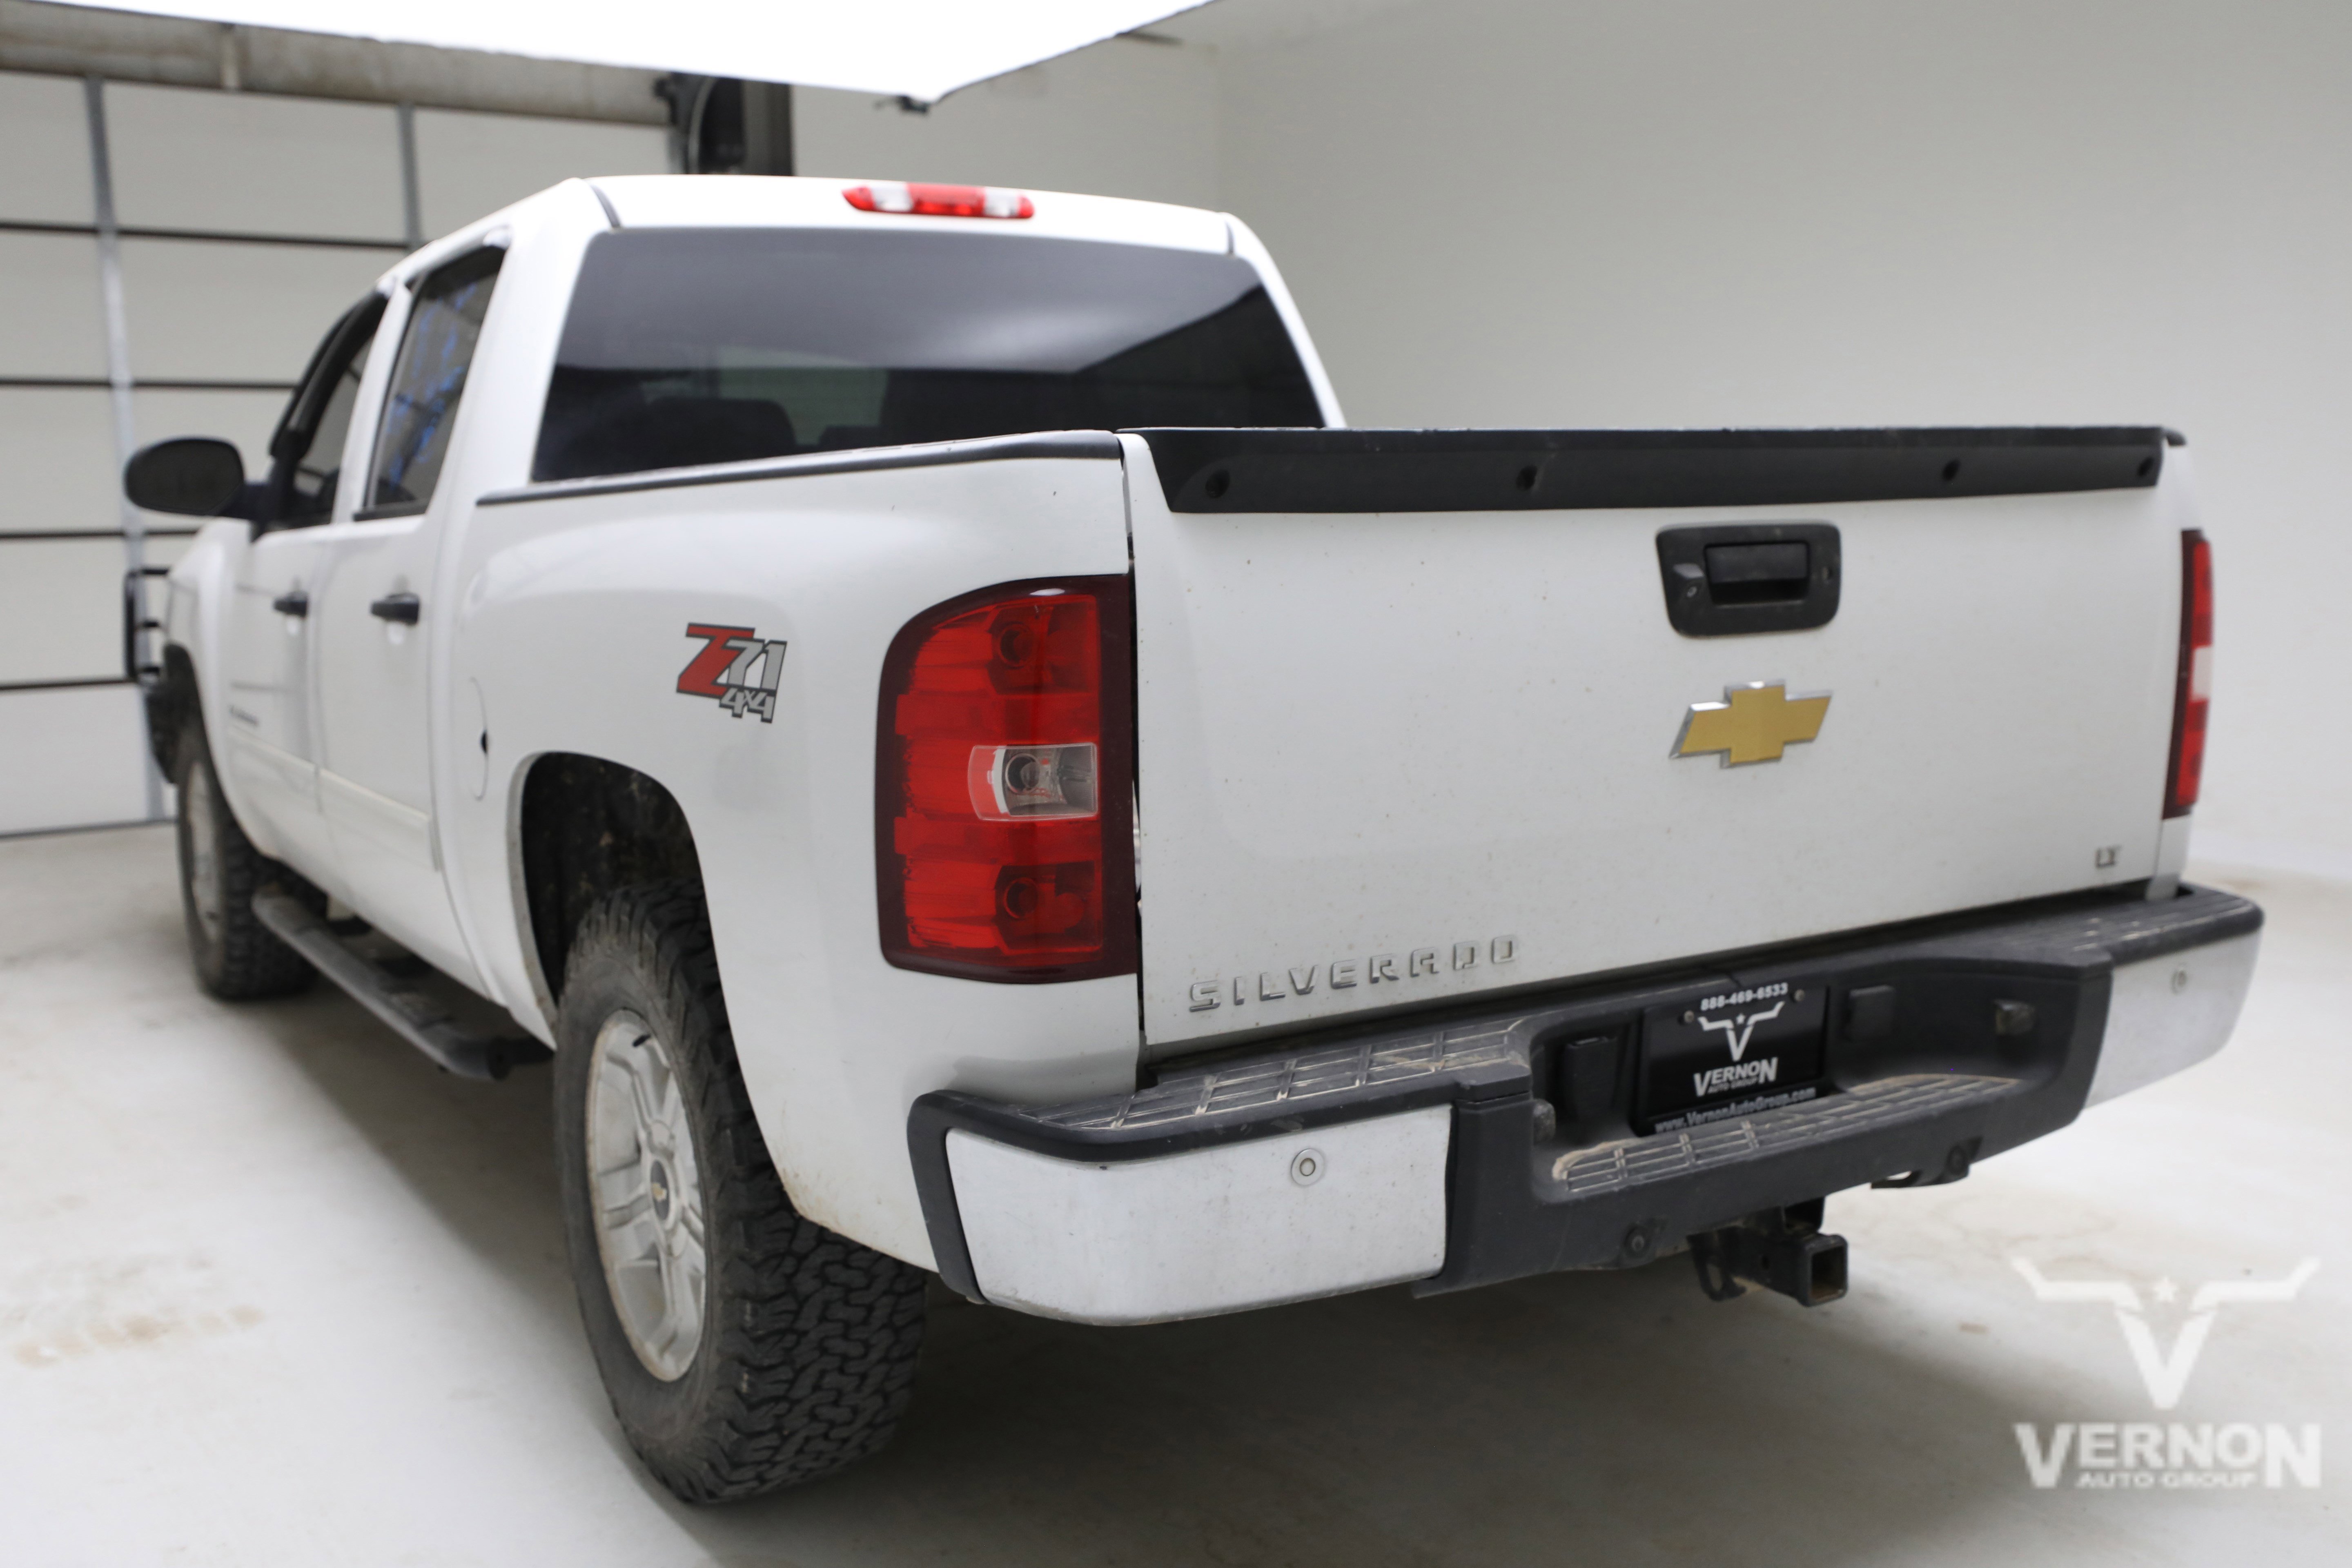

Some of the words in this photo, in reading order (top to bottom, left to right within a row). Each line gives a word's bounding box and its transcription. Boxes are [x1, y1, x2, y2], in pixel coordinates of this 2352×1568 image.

[676, 622, 787, 699] Z71
[1189, 934, 1519, 1013] SILVERADO
[1693, 1056, 1779, 1097] VERNON
